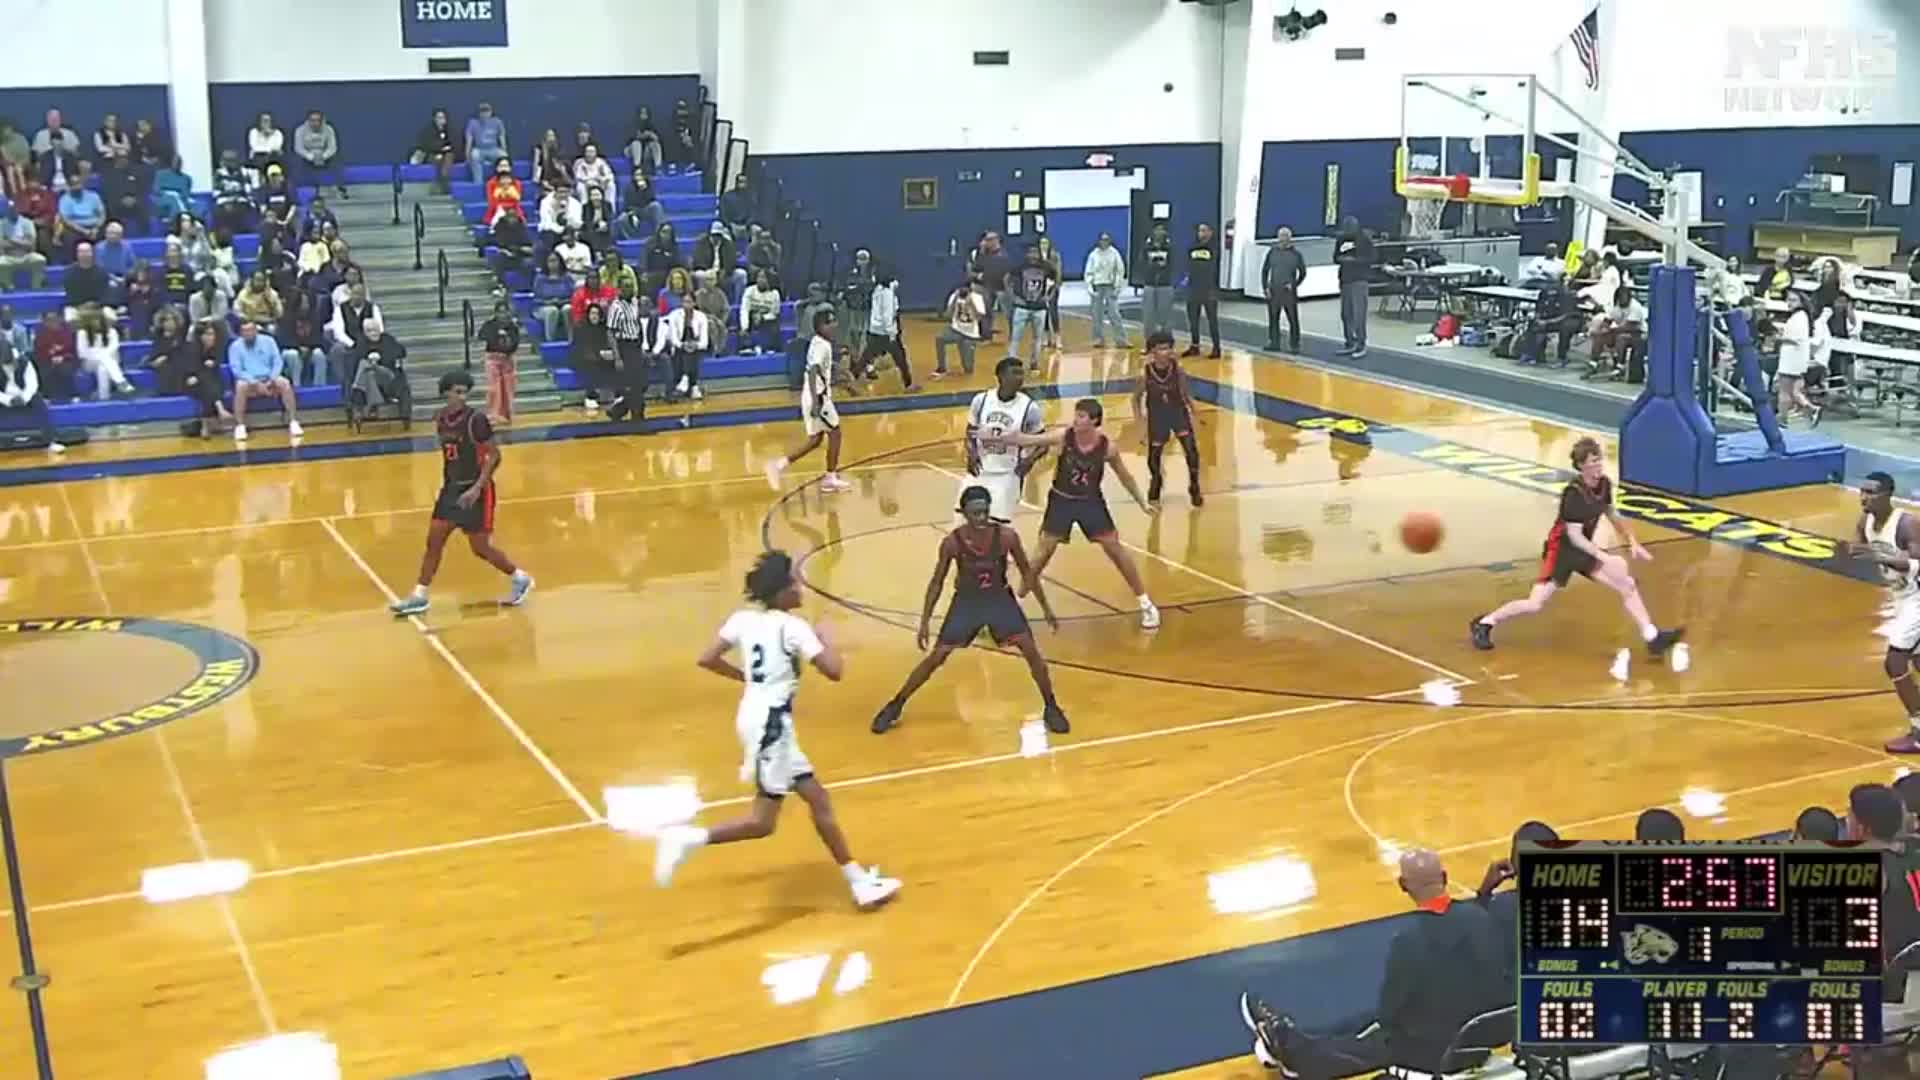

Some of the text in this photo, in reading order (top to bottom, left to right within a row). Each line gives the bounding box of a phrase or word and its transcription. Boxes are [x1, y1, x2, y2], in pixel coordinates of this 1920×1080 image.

[416, 1, 492, 20] HOME
[1409, 441, 1838, 559] WILCATS
[752, 643, 766, 683] 2
